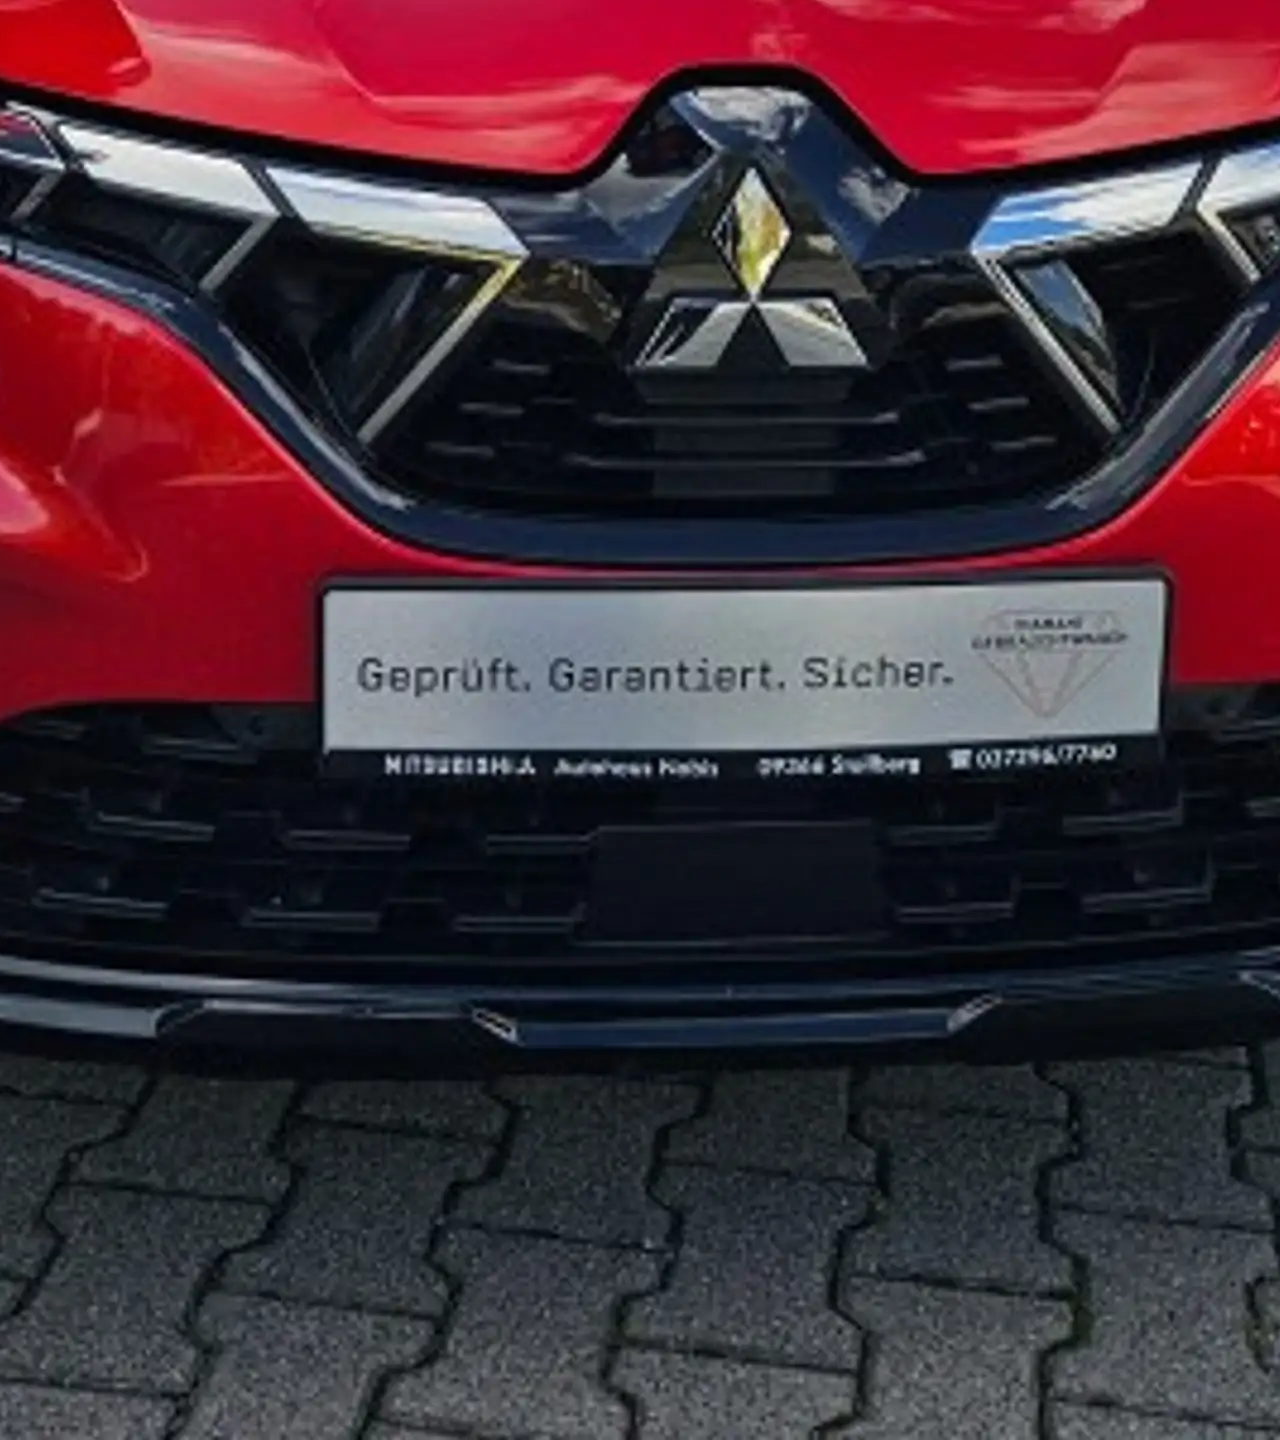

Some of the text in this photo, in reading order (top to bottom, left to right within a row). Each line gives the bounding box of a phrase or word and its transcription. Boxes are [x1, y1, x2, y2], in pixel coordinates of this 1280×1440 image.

[356, 655, 955, 698] Geprüft. Garantiert. Sicher.
